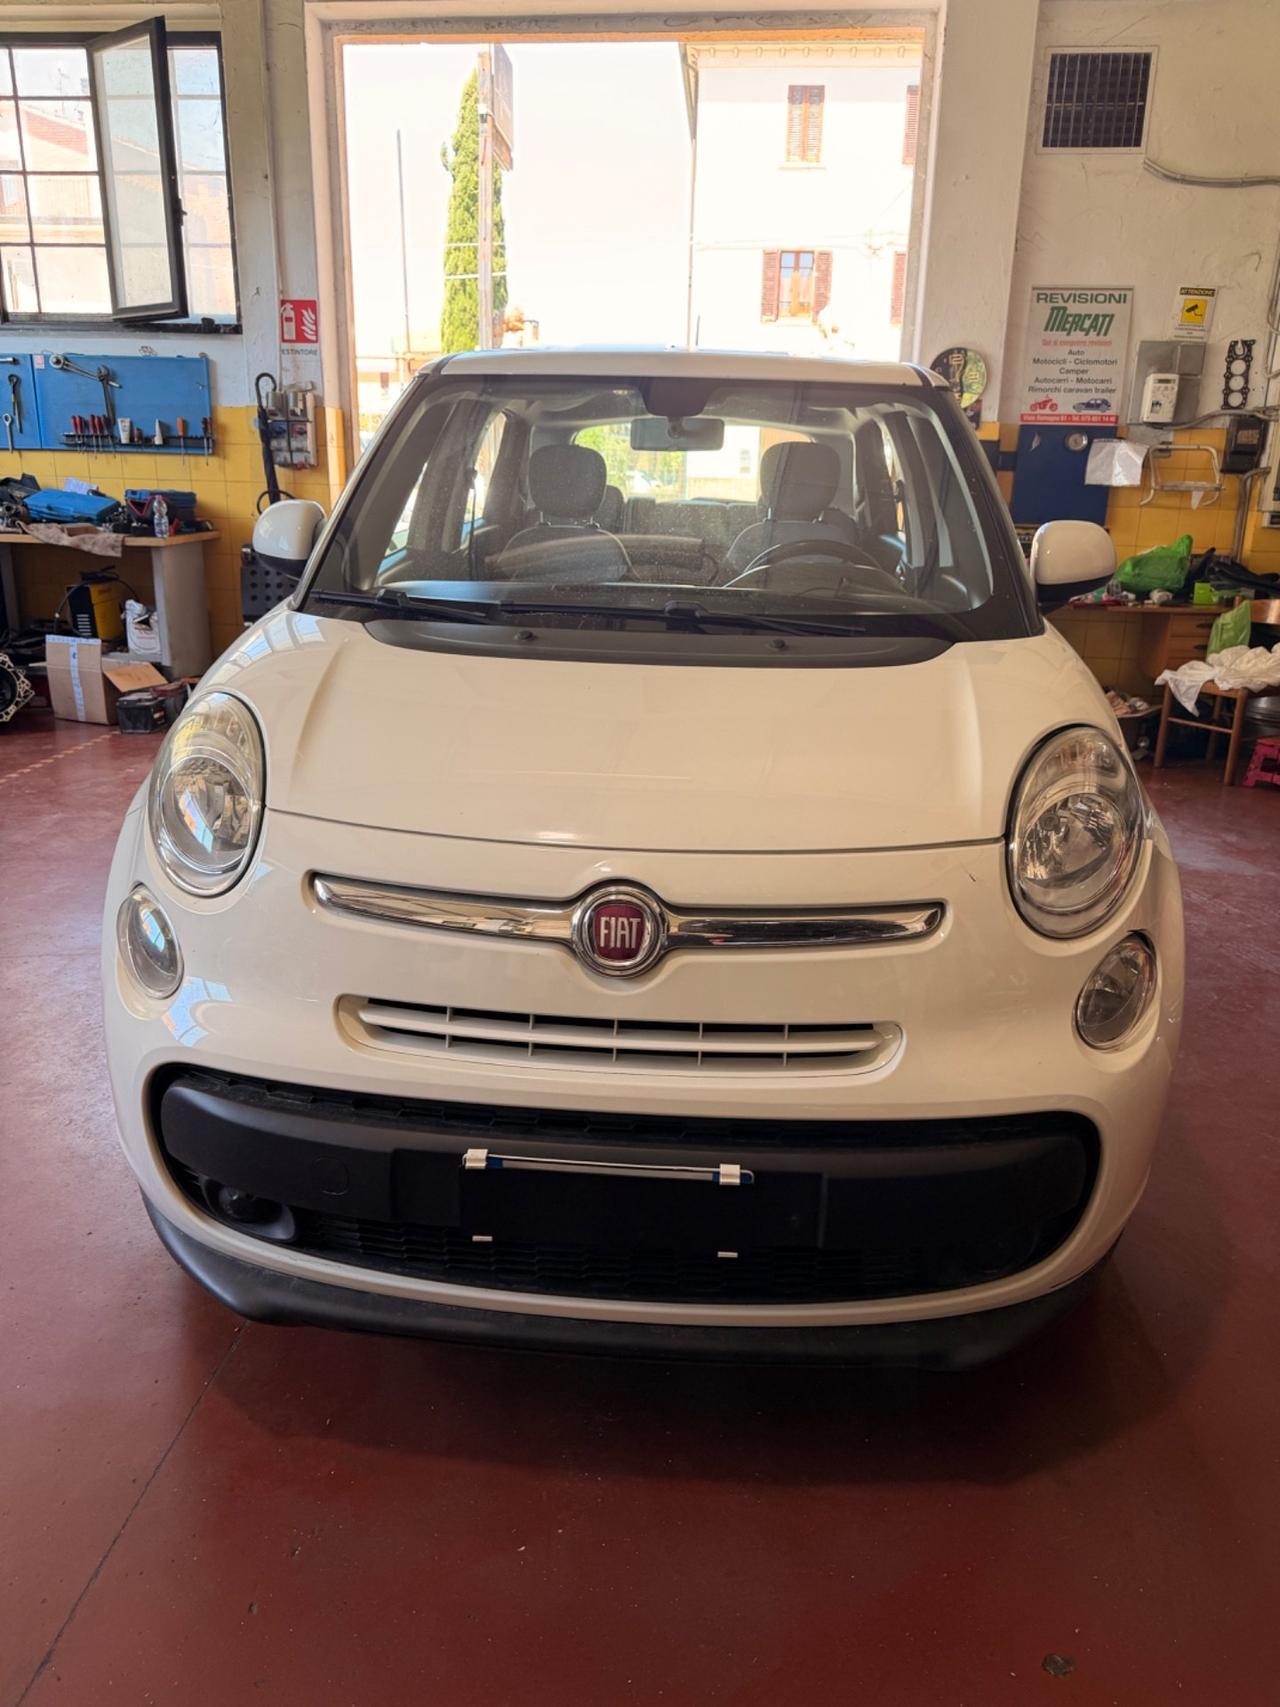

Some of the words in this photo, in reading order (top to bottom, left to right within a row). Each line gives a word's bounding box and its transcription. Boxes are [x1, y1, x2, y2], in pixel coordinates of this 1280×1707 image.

[1036, 292, 1127, 304] REVISIONI
[281, 348, 317, 356] ESTINTORE
[1059, 367, 1088, 375] Camper
[1094, 386, 1116, 394] trailer
[599, 916, 641, 949] FIAT
